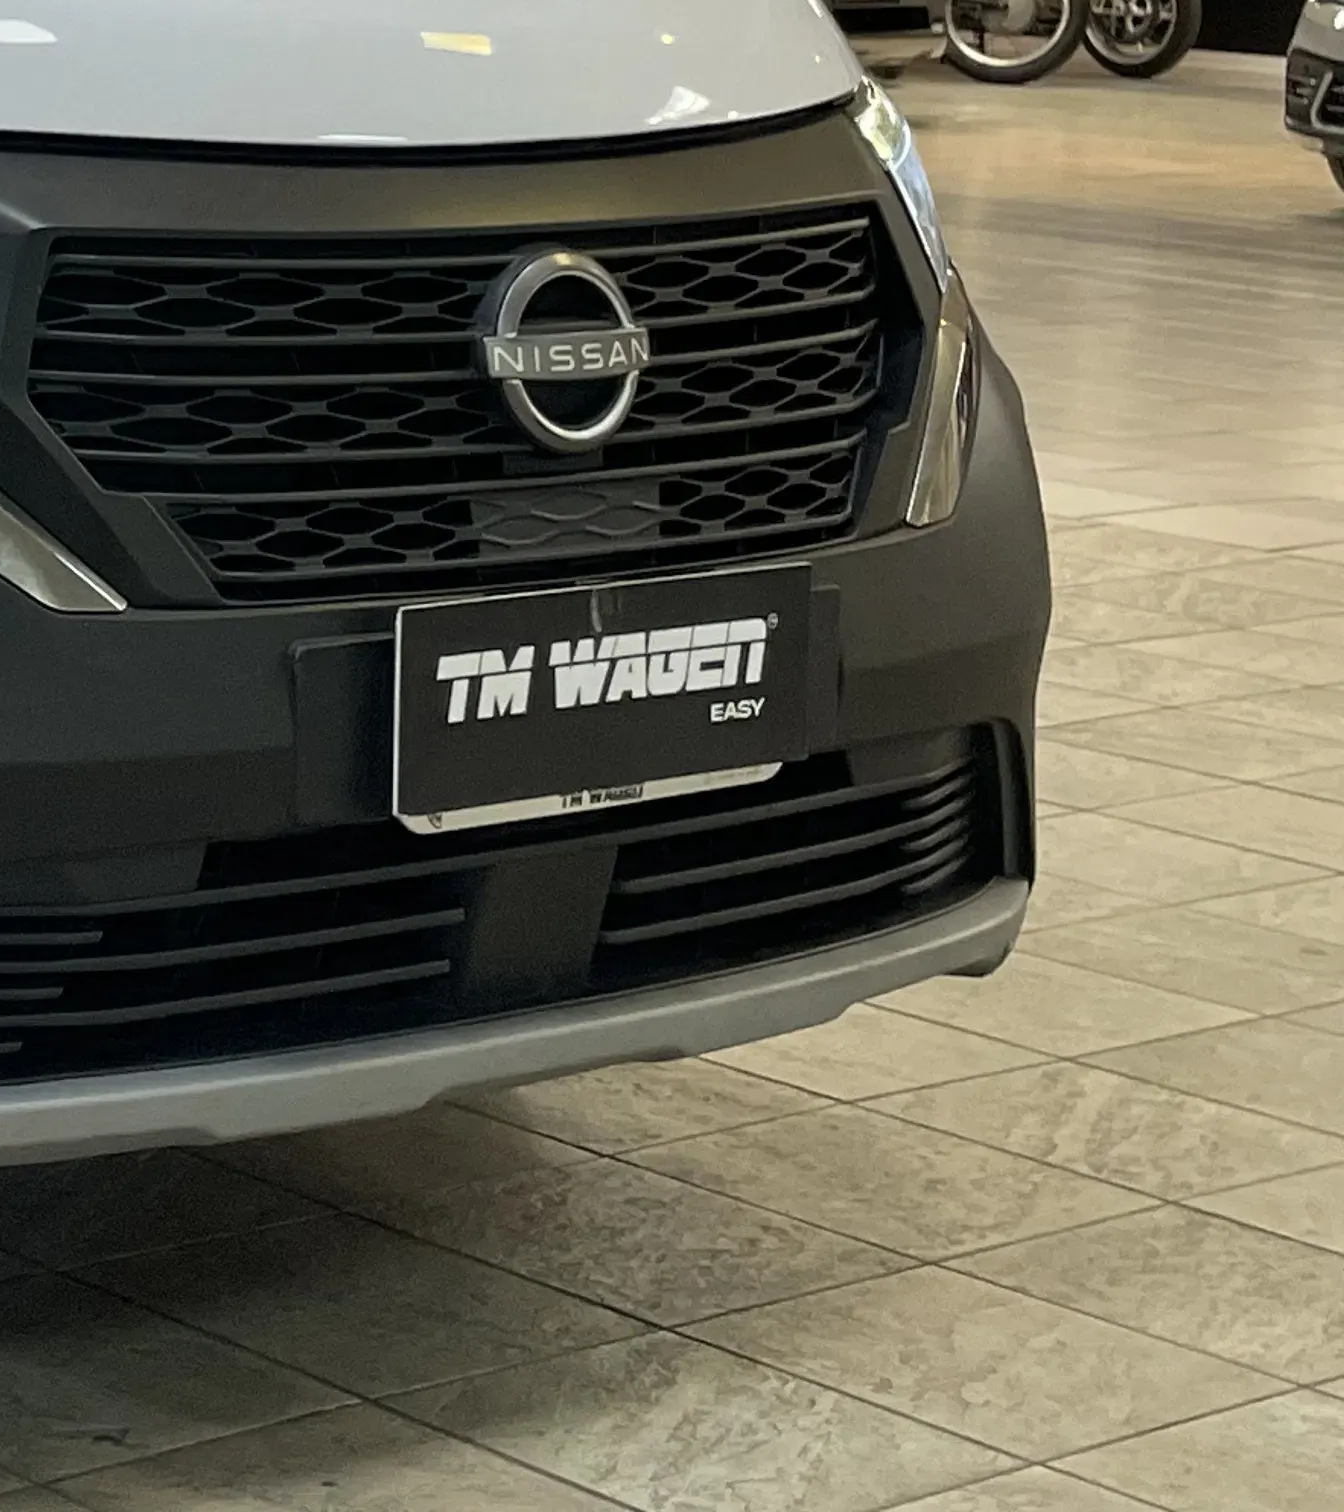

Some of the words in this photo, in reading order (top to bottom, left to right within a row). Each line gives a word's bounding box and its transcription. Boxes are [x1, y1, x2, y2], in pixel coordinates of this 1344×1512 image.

[493, 337, 649, 373] NISSAN
[436, 645, 535, 724] TM
[548, 617, 768, 709] WAGEN
[709, 696, 766, 724] EASY
